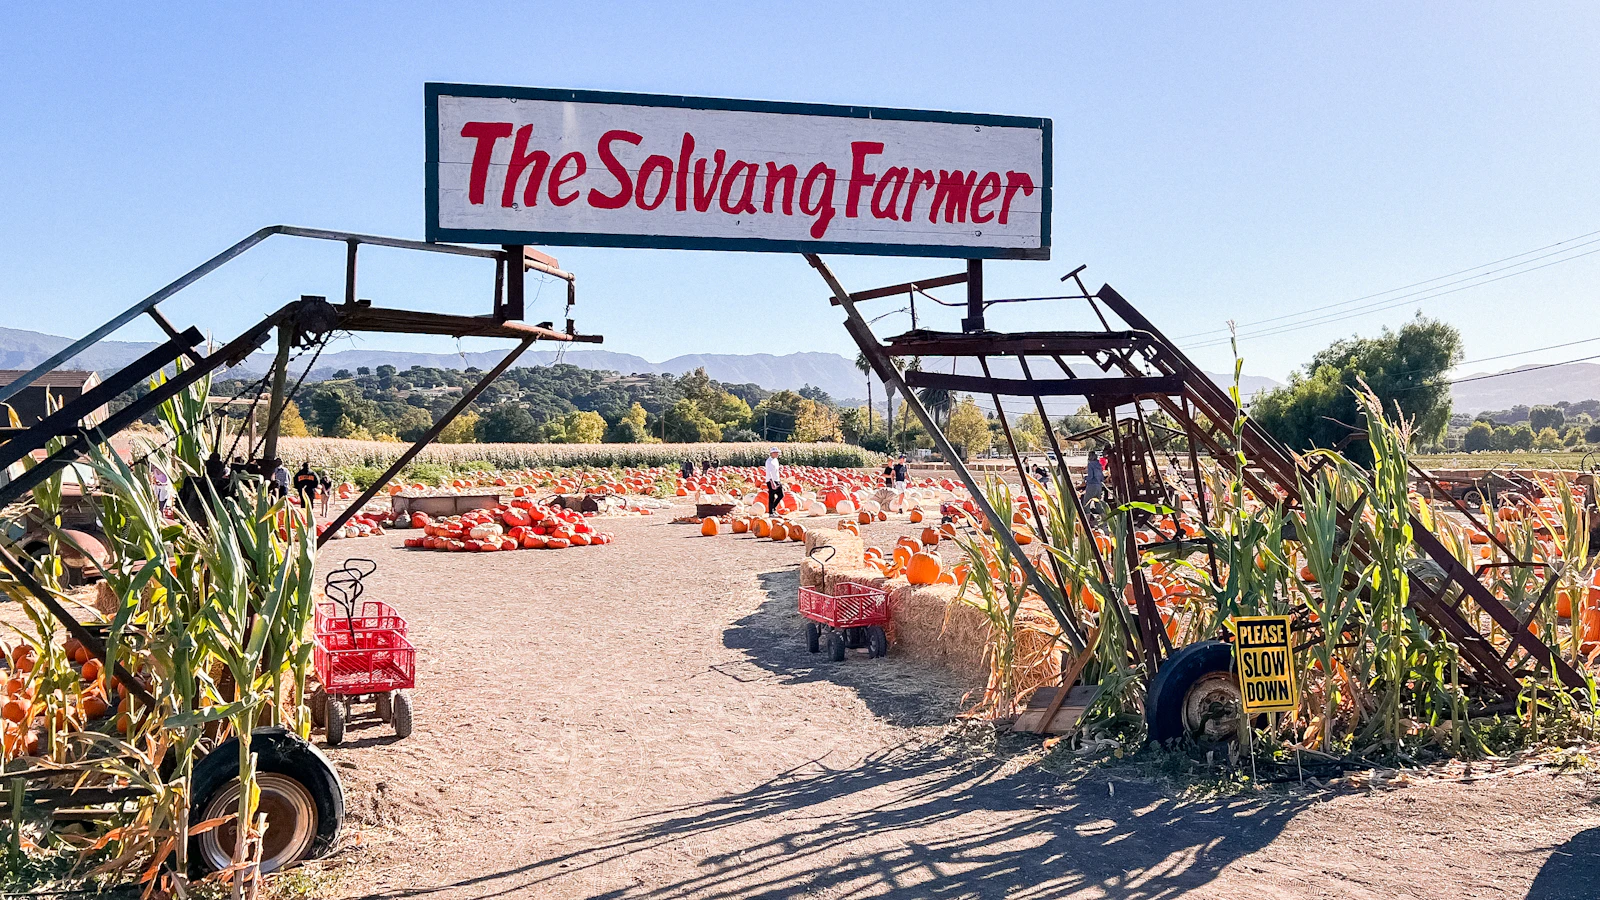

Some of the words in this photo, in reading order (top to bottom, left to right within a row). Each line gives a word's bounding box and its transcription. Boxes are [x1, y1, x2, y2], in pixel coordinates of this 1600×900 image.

[461, 122, 586, 209] The
[587, 130, 836, 239] Solvang
[846, 142, 1034, 224] Farmer
[1240, 625, 1285, 645] PLEASE
[1243, 651, 1285, 678] SLOW
[1246, 680, 1289, 702] DOWN
